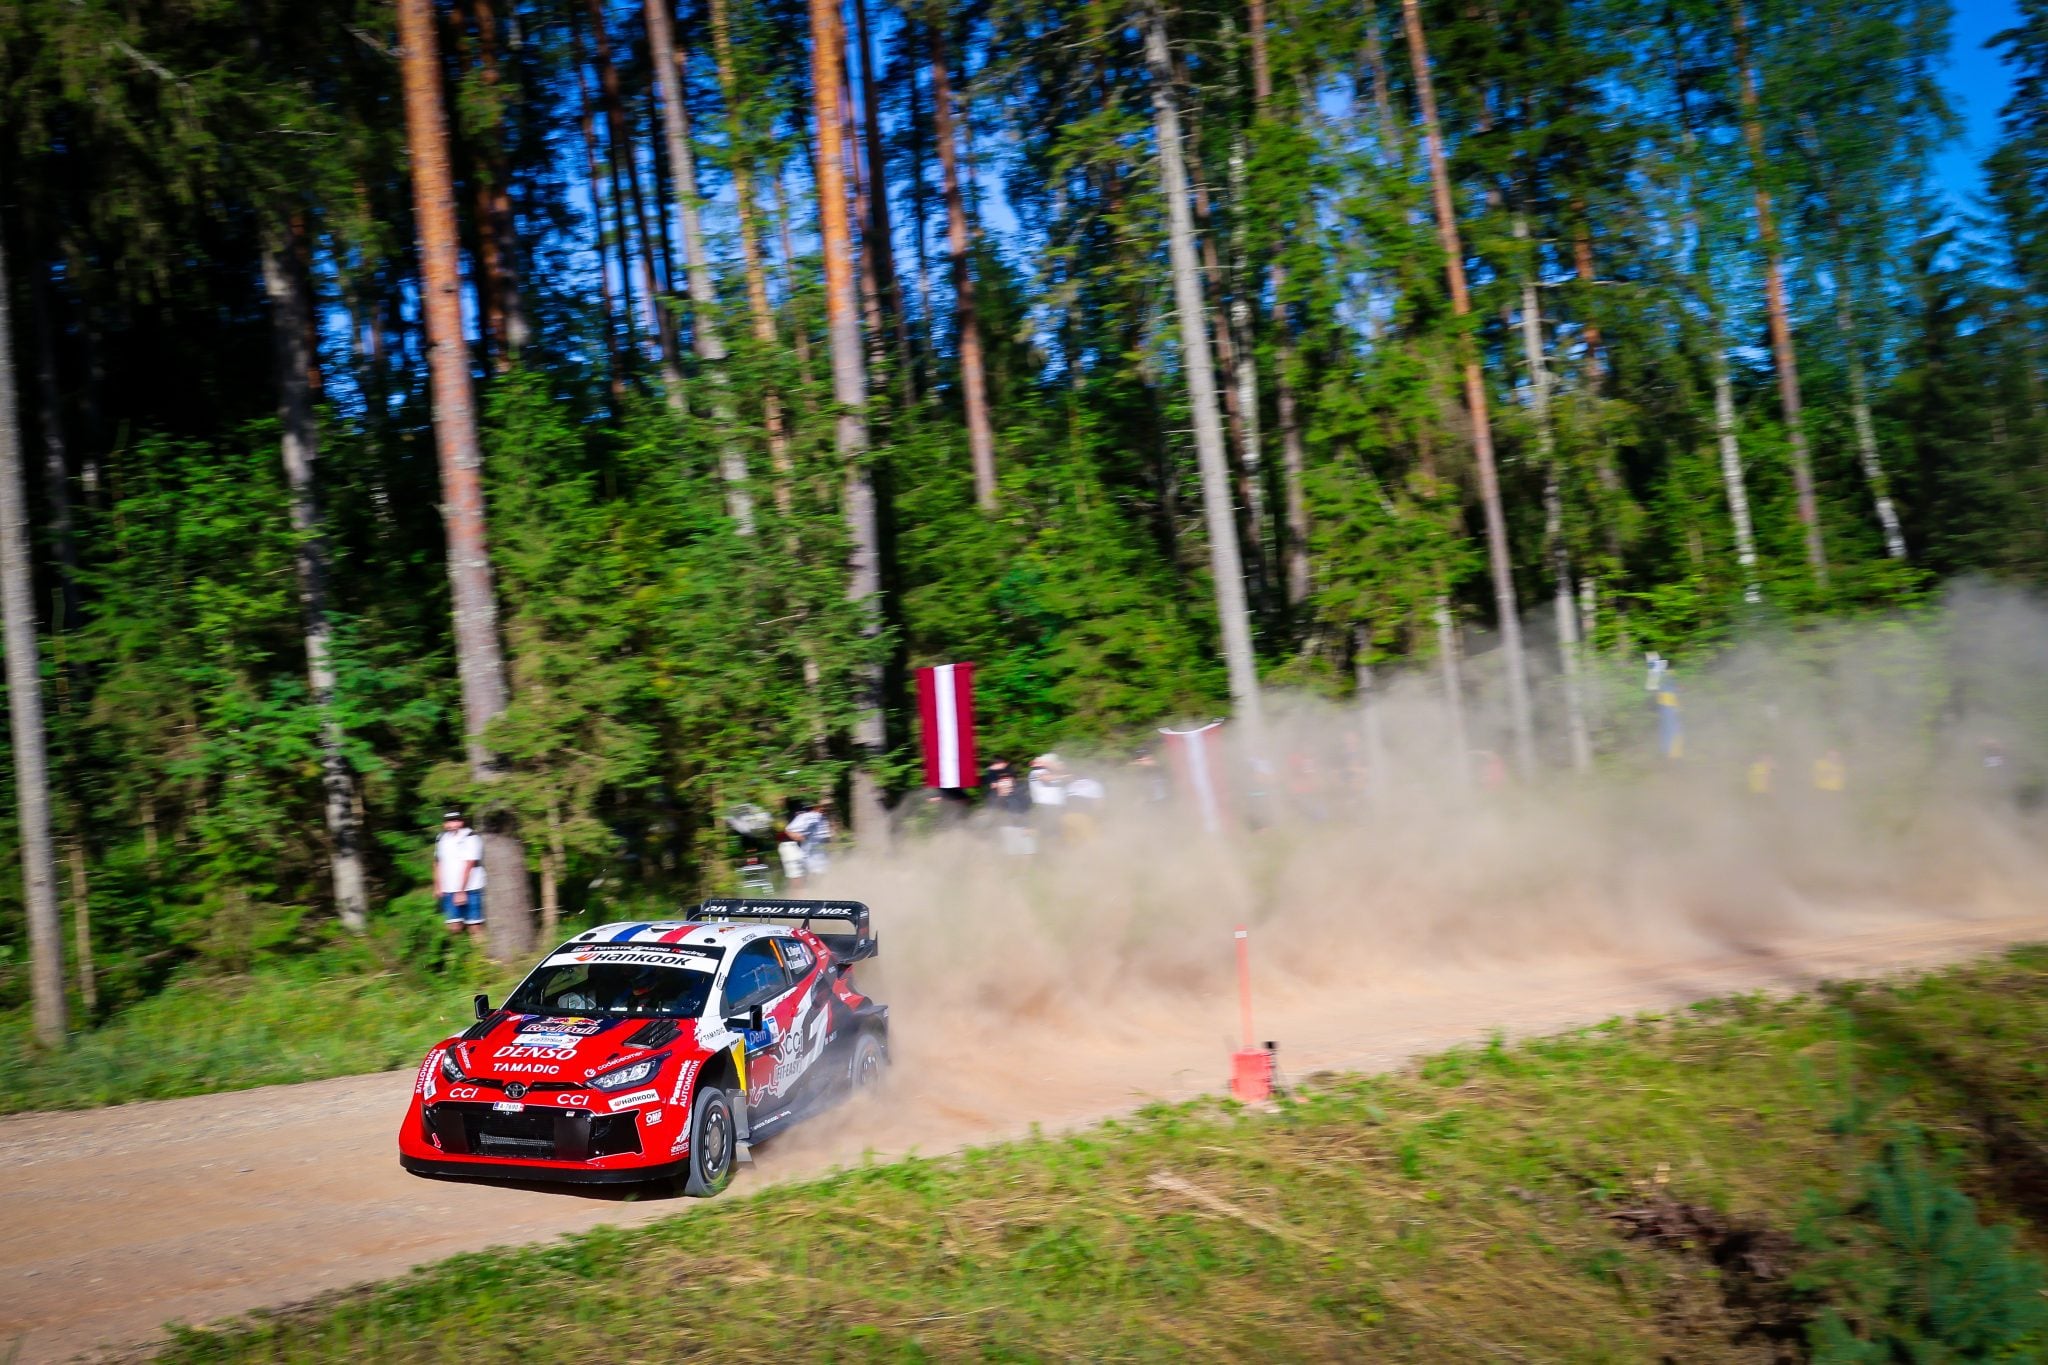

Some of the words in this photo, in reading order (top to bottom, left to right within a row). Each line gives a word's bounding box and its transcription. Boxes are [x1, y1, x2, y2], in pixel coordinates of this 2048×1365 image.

[671, 948, 707, 956] Racing
[521, 1023, 562, 1032] Red
[560, 1025, 600, 1035] Bull
[492, 1046, 578, 1060] DENSO
[598, 1051, 643, 1071] codebeamer
[415, 1048, 438, 1094] AUTOMOTIVE
[492, 1063, 560, 1075] TAMADIC
[669, 1060, 691, 1105] Panasonic
[449, 1088, 479, 1098] CCI
[557, 1094, 589, 1106] CCI
[645, 1111, 662, 1123] OMP
